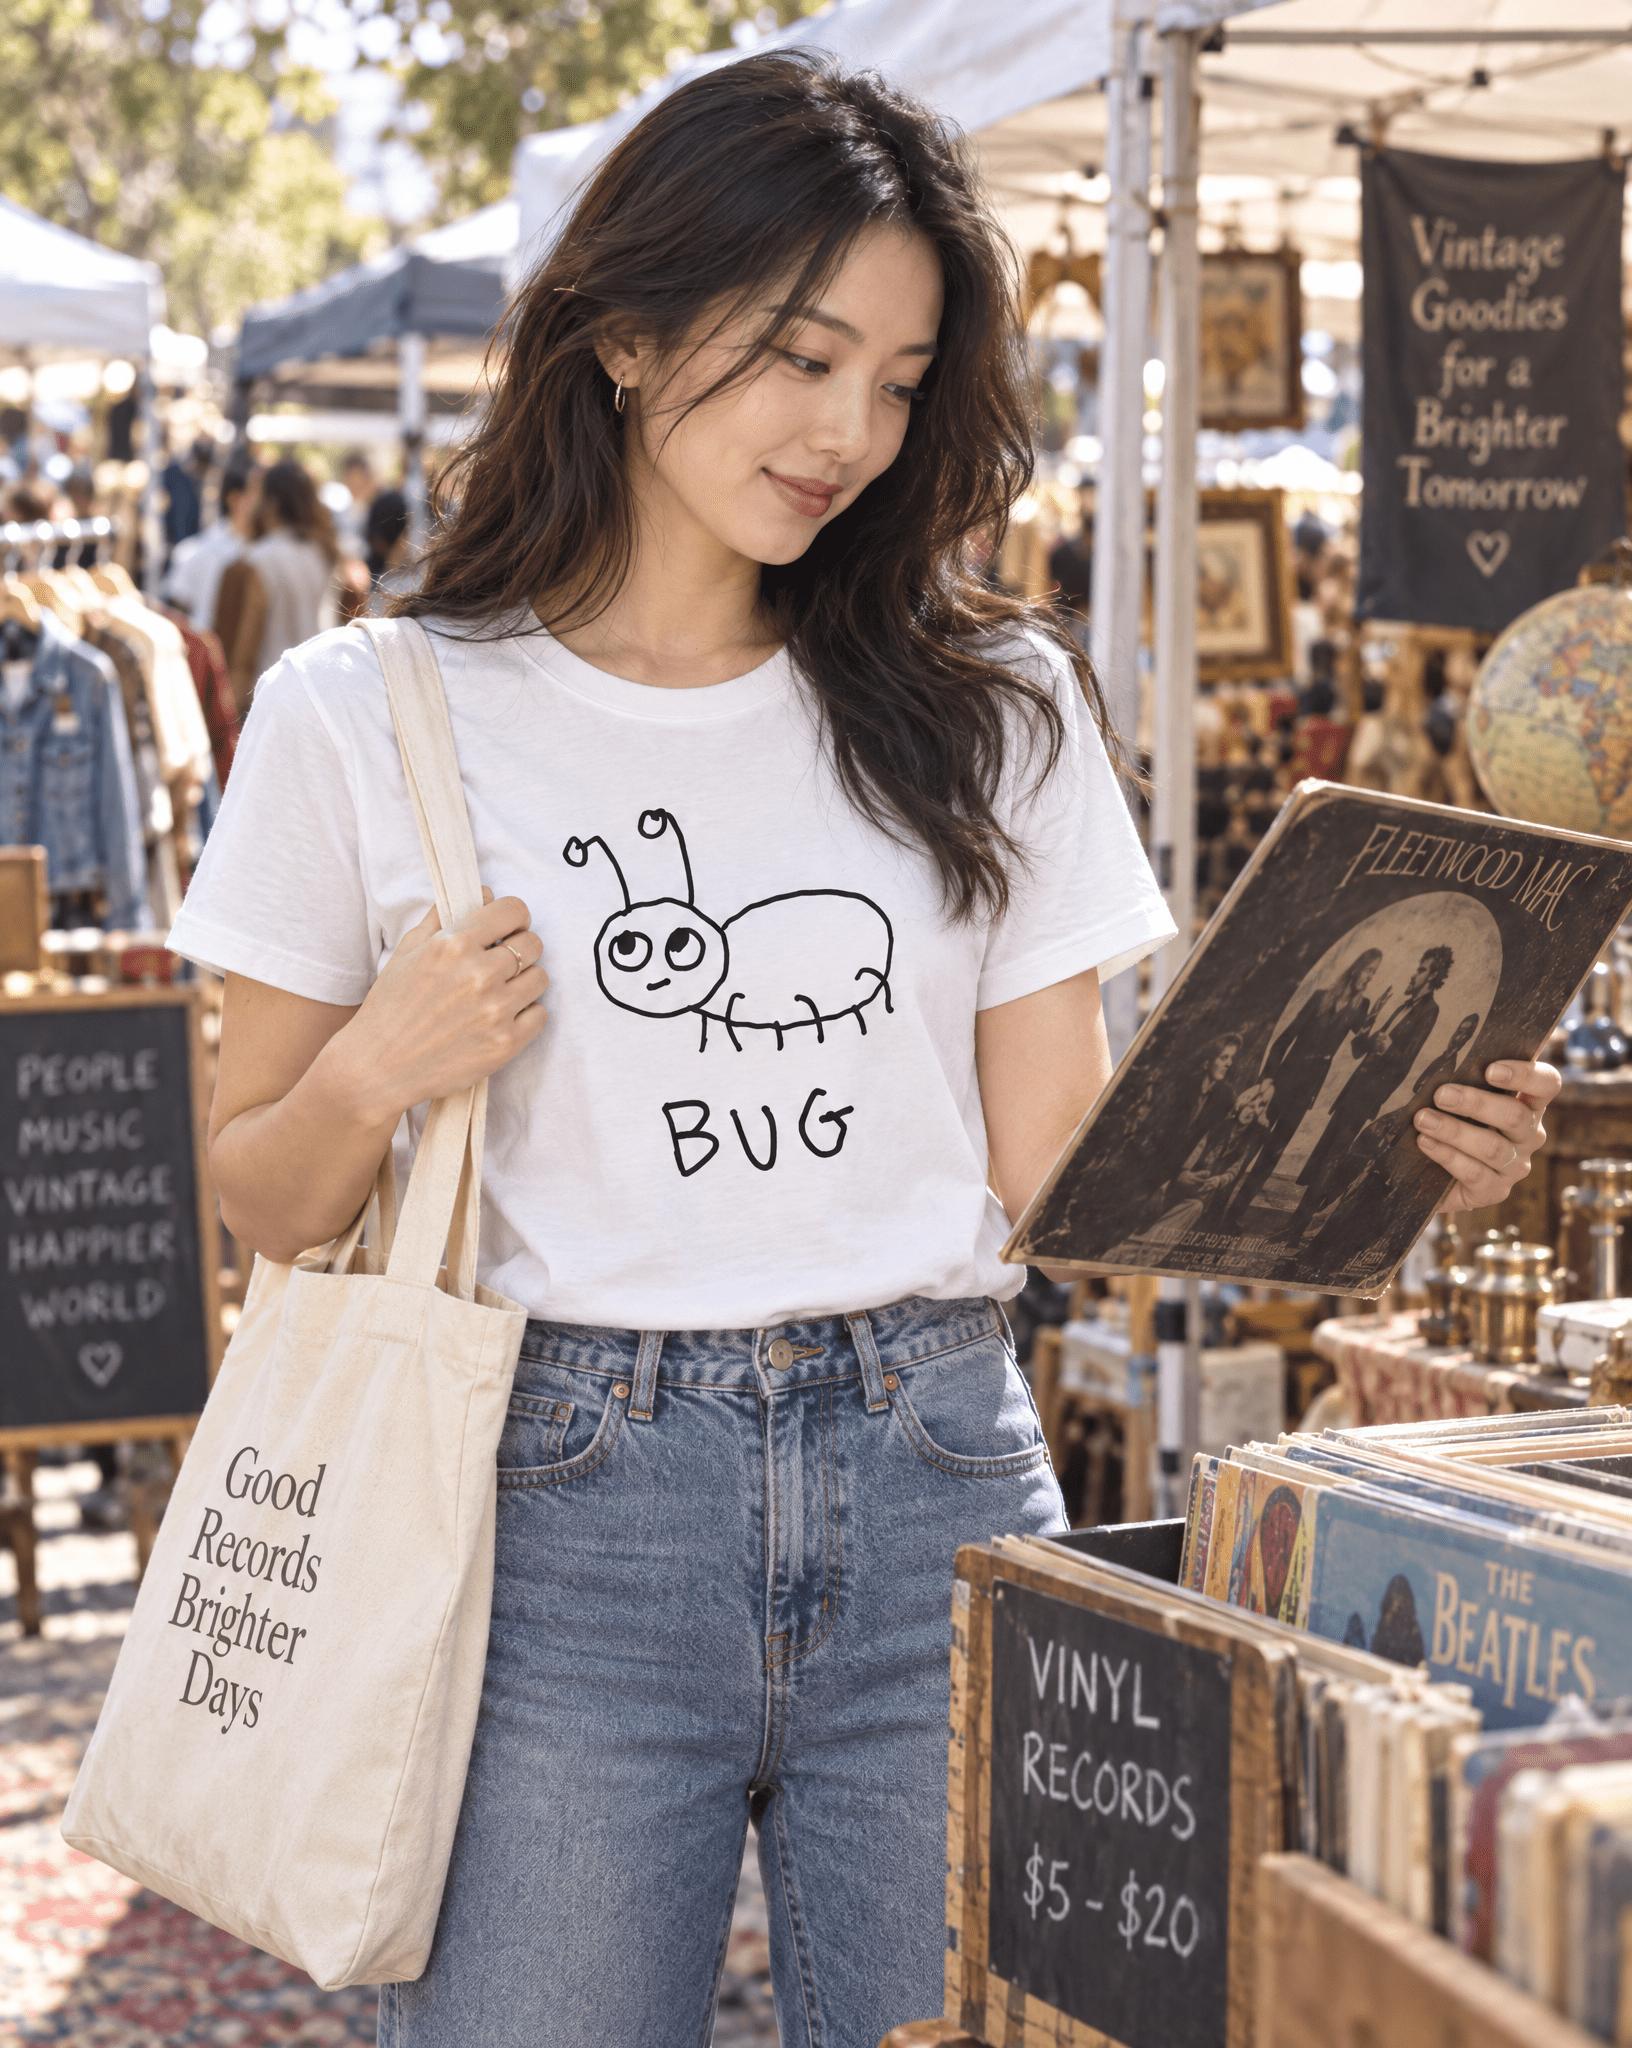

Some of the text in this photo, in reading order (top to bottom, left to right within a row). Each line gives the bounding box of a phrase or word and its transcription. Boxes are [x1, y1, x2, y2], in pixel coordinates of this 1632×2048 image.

[1410, 214, 1566, 284] Vintage
[1411, 278, 1567, 332] Goodies
[1440, 339, 1531, 399] for a
[1414, 397, 1568, 466] Brighter
[1397, 455, 1587, 509] Tomorrow
[1335, 823, 1598, 931] FLEETWOOD MAC
[16, 1048, 159, 1098] PEOPLE
[18, 1108, 143, 1157] MUSIC
[662, 1088, 854, 1177] BUG
[5, 1163, 173, 1217] VINTAGE
[8, 1220, 175, 1273] HAPPIER
[21, 1278, 166, 1329] WORLD
[225, 1446, 327, 1518] Good
[188, 1507, 322, 1593] Records
[1484, 1560, 1536, 1605] THE
[168, 1573, 307, 1665] Brighter
[1431, 1571, 1596, 1708] BEATLES
[179, 1650, 263, 1734] Days
[1027, 1636, 1160, 1729] VINYL
[1023, 1731, 1197, 1841] RECORDS
[1023, 1842, 1070, 1921] $5
[1118, 1869, 1199, 1957] $20
